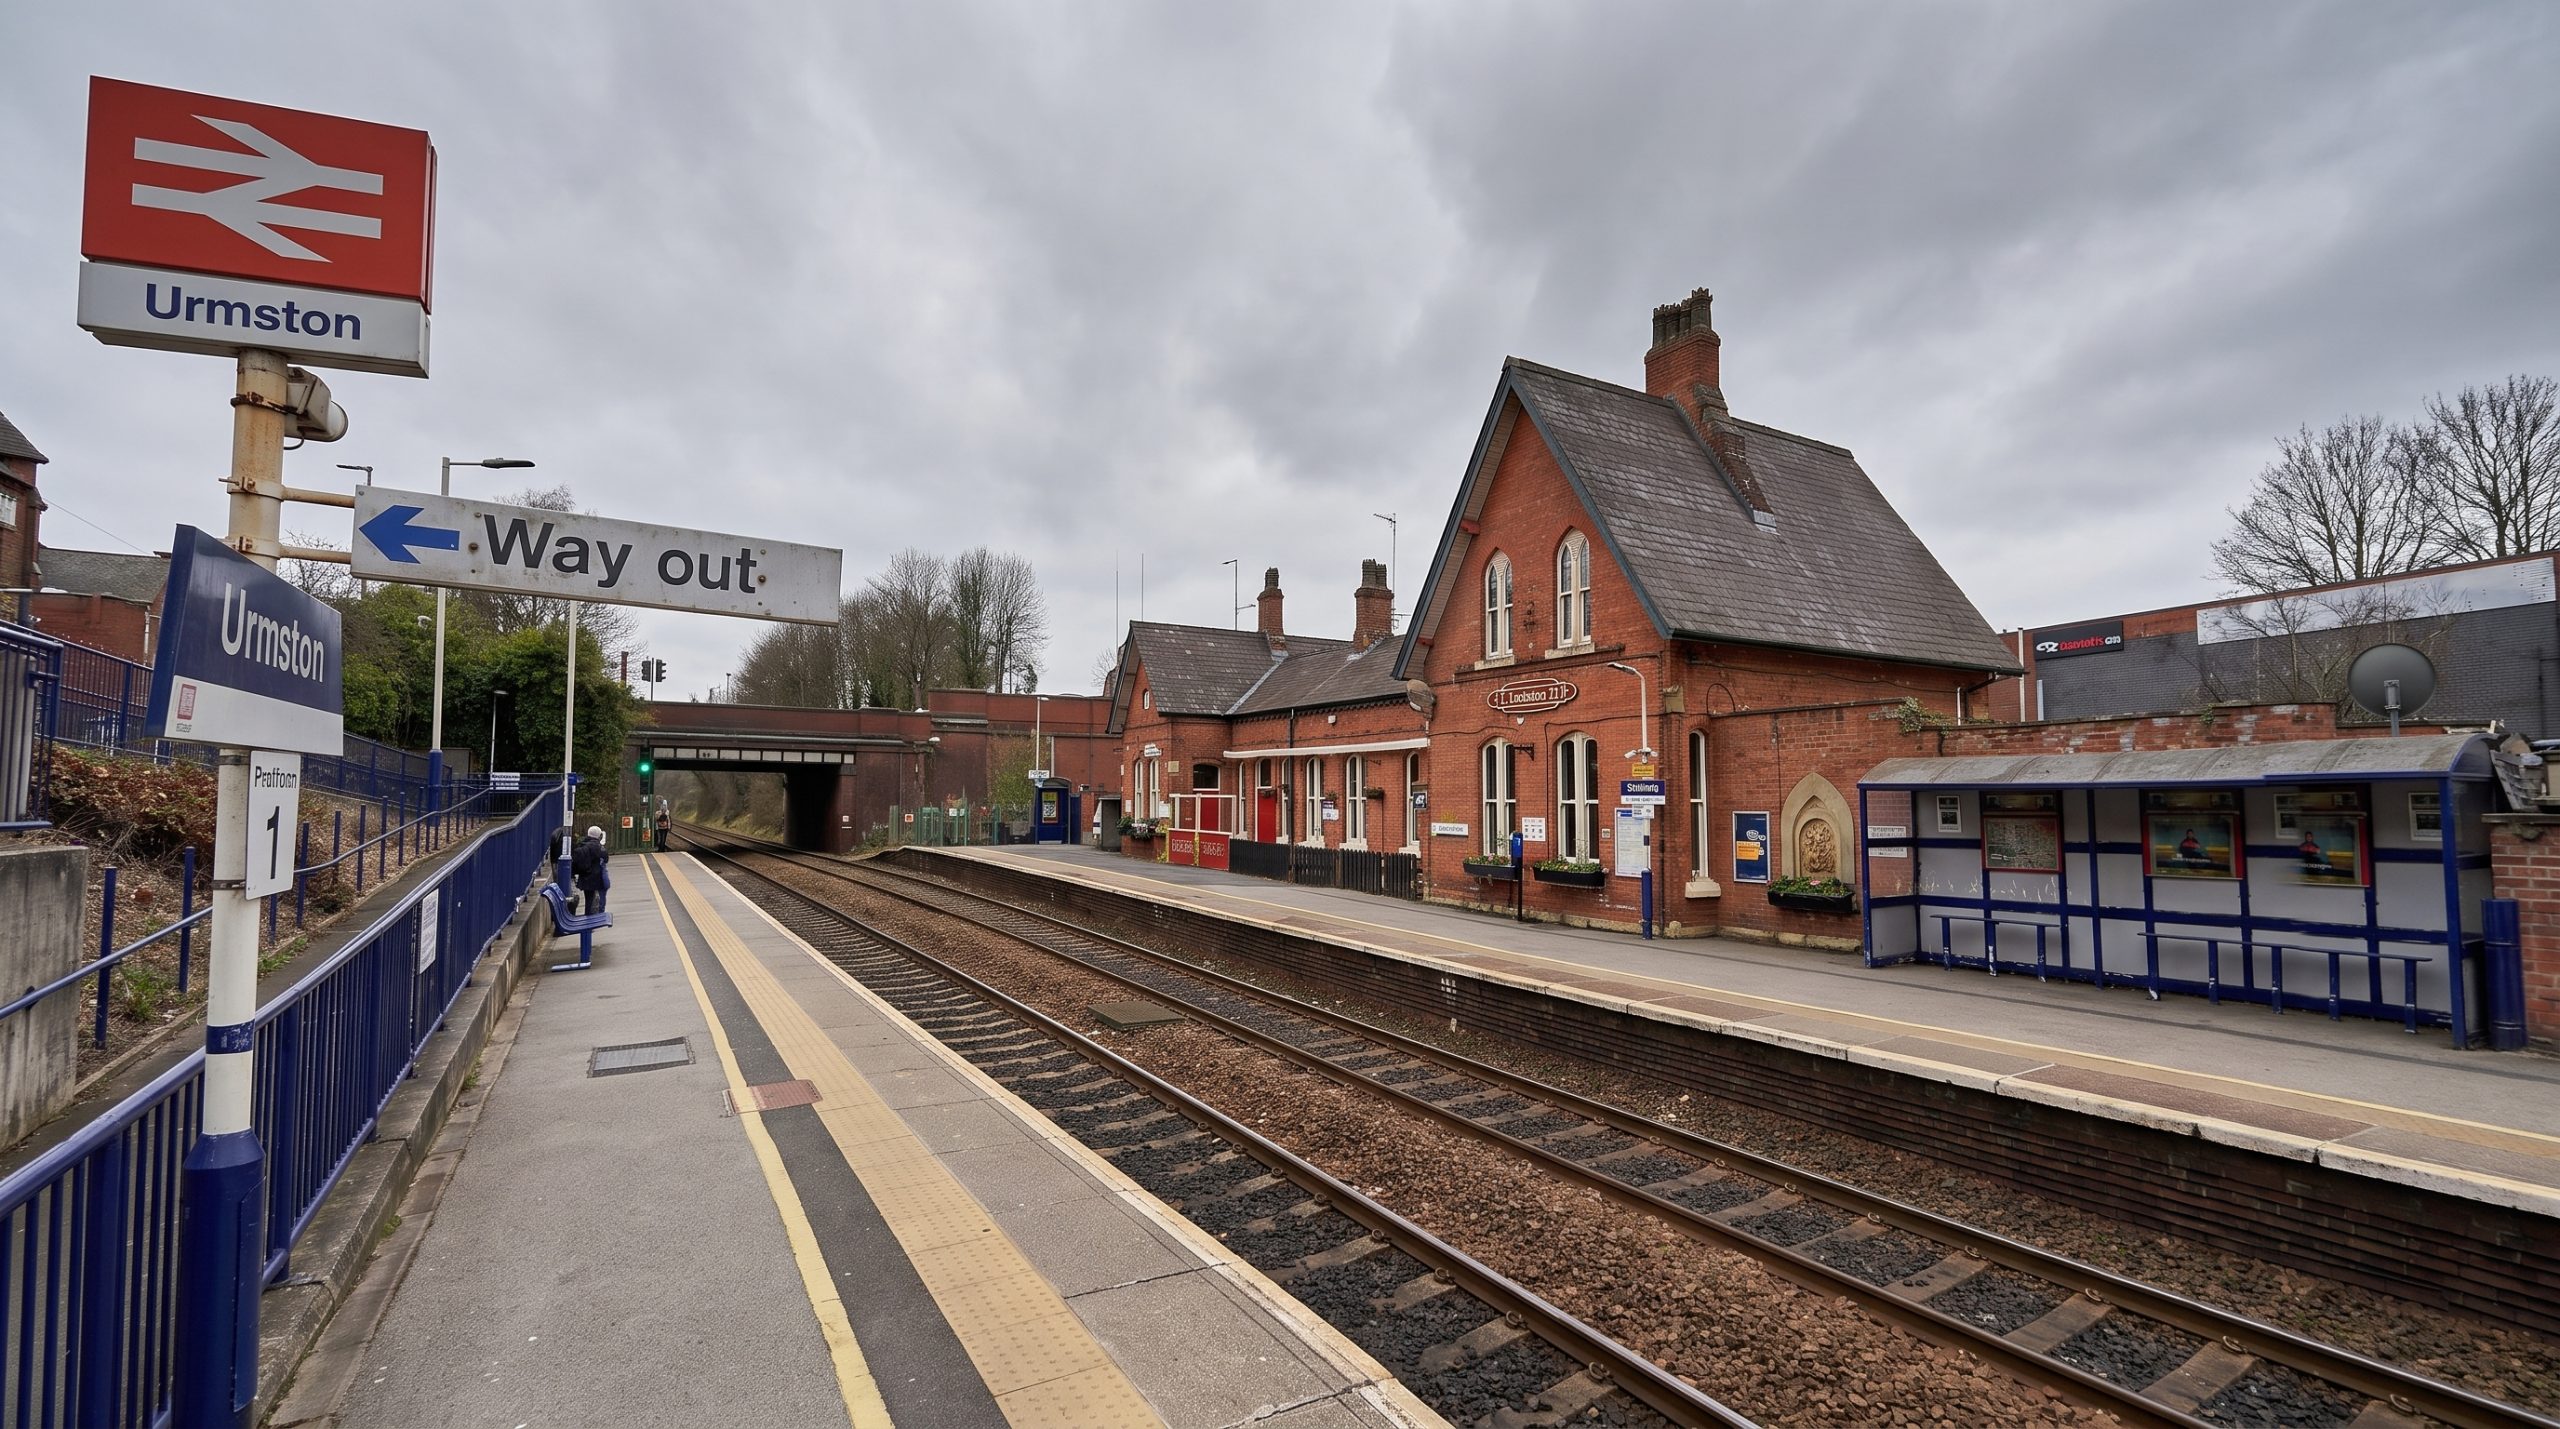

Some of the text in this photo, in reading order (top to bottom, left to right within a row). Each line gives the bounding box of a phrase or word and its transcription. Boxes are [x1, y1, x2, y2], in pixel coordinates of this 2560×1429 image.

[145, 283, 361, 340] Urmston
[484, 514, 757, 594] Way out
[221, 582, 324, 683] Urmston
[266, 805, 280, 880] 1
